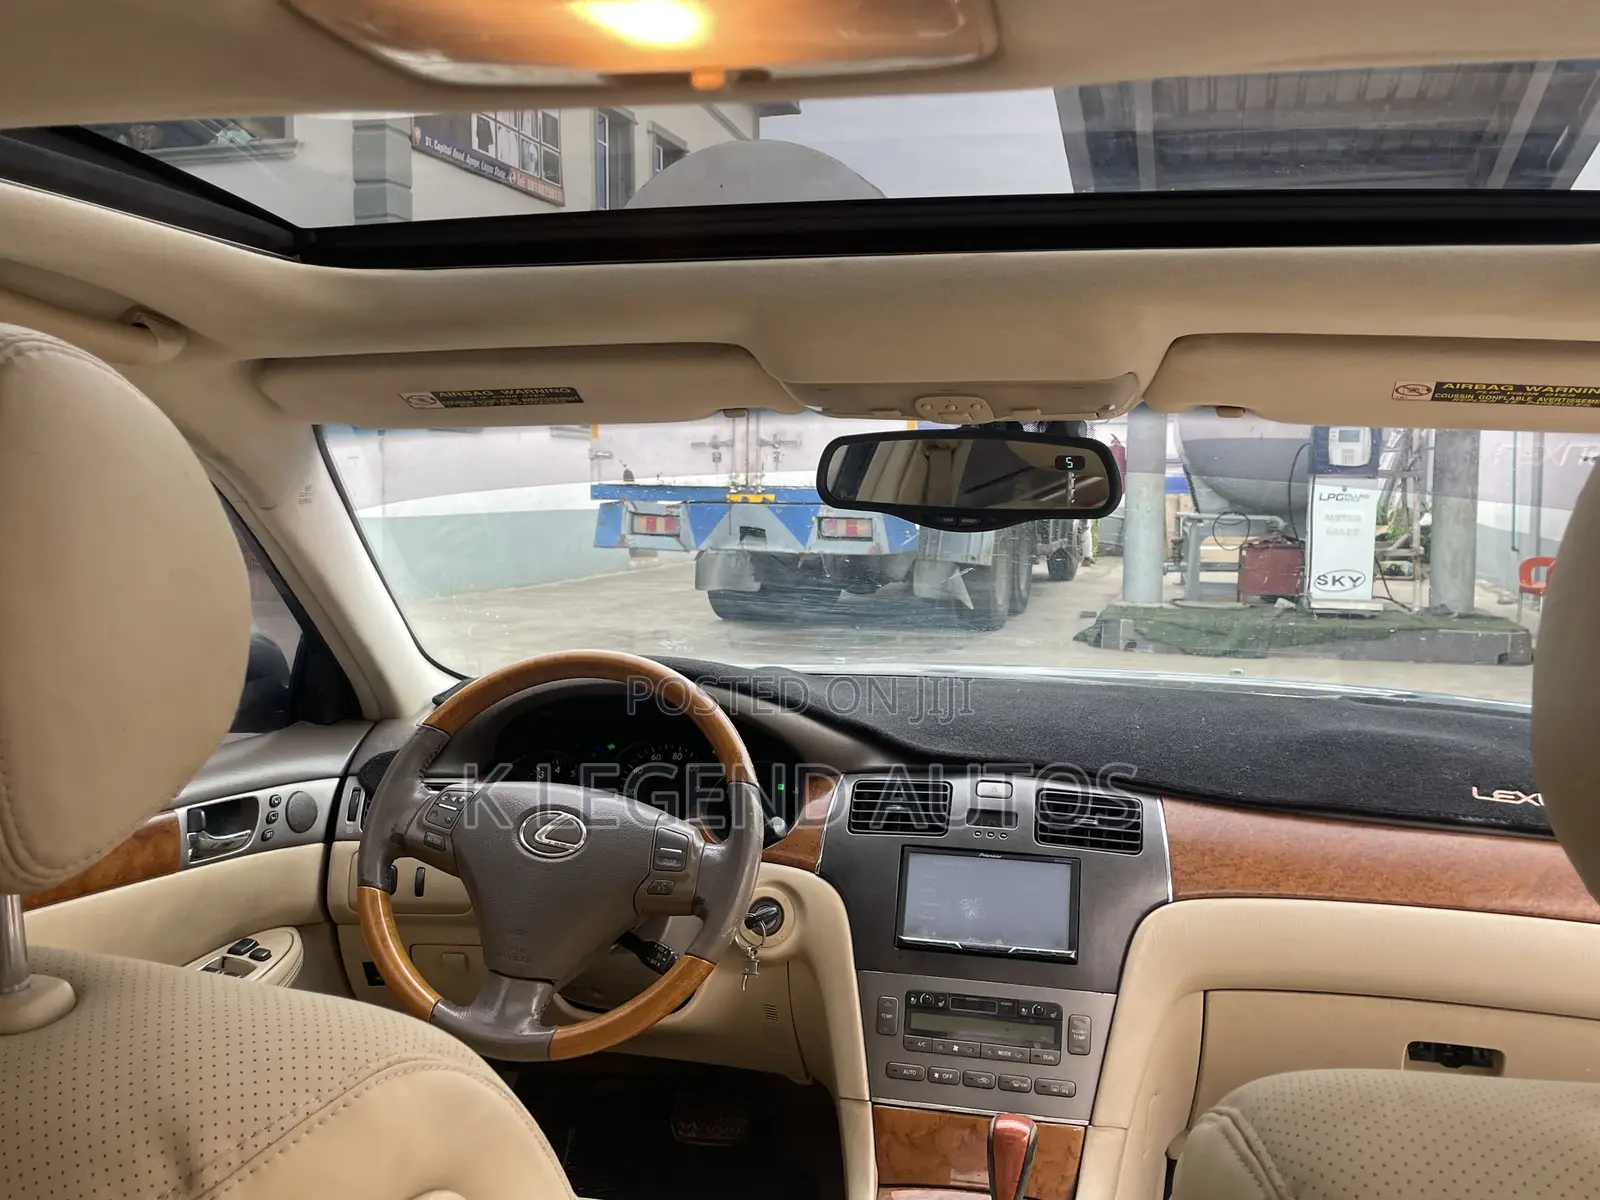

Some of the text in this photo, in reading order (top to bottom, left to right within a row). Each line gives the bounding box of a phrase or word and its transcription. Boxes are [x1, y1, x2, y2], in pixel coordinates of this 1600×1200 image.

[434, 140, 452, 156] Capital
[1442, 383, 1514, 392] AIRBAG
[1319, 493, 1344, 502] LPG
[1316, 575, 1362, 588] SKY
[651, 753, 661, 761] 60
[672, 753, 683, 761] 80
[917, 1041, 927, 1049] A/C
[997, 1050, 1012, 1058] MODE
[903, 1069, 917, 1077] AUTO
